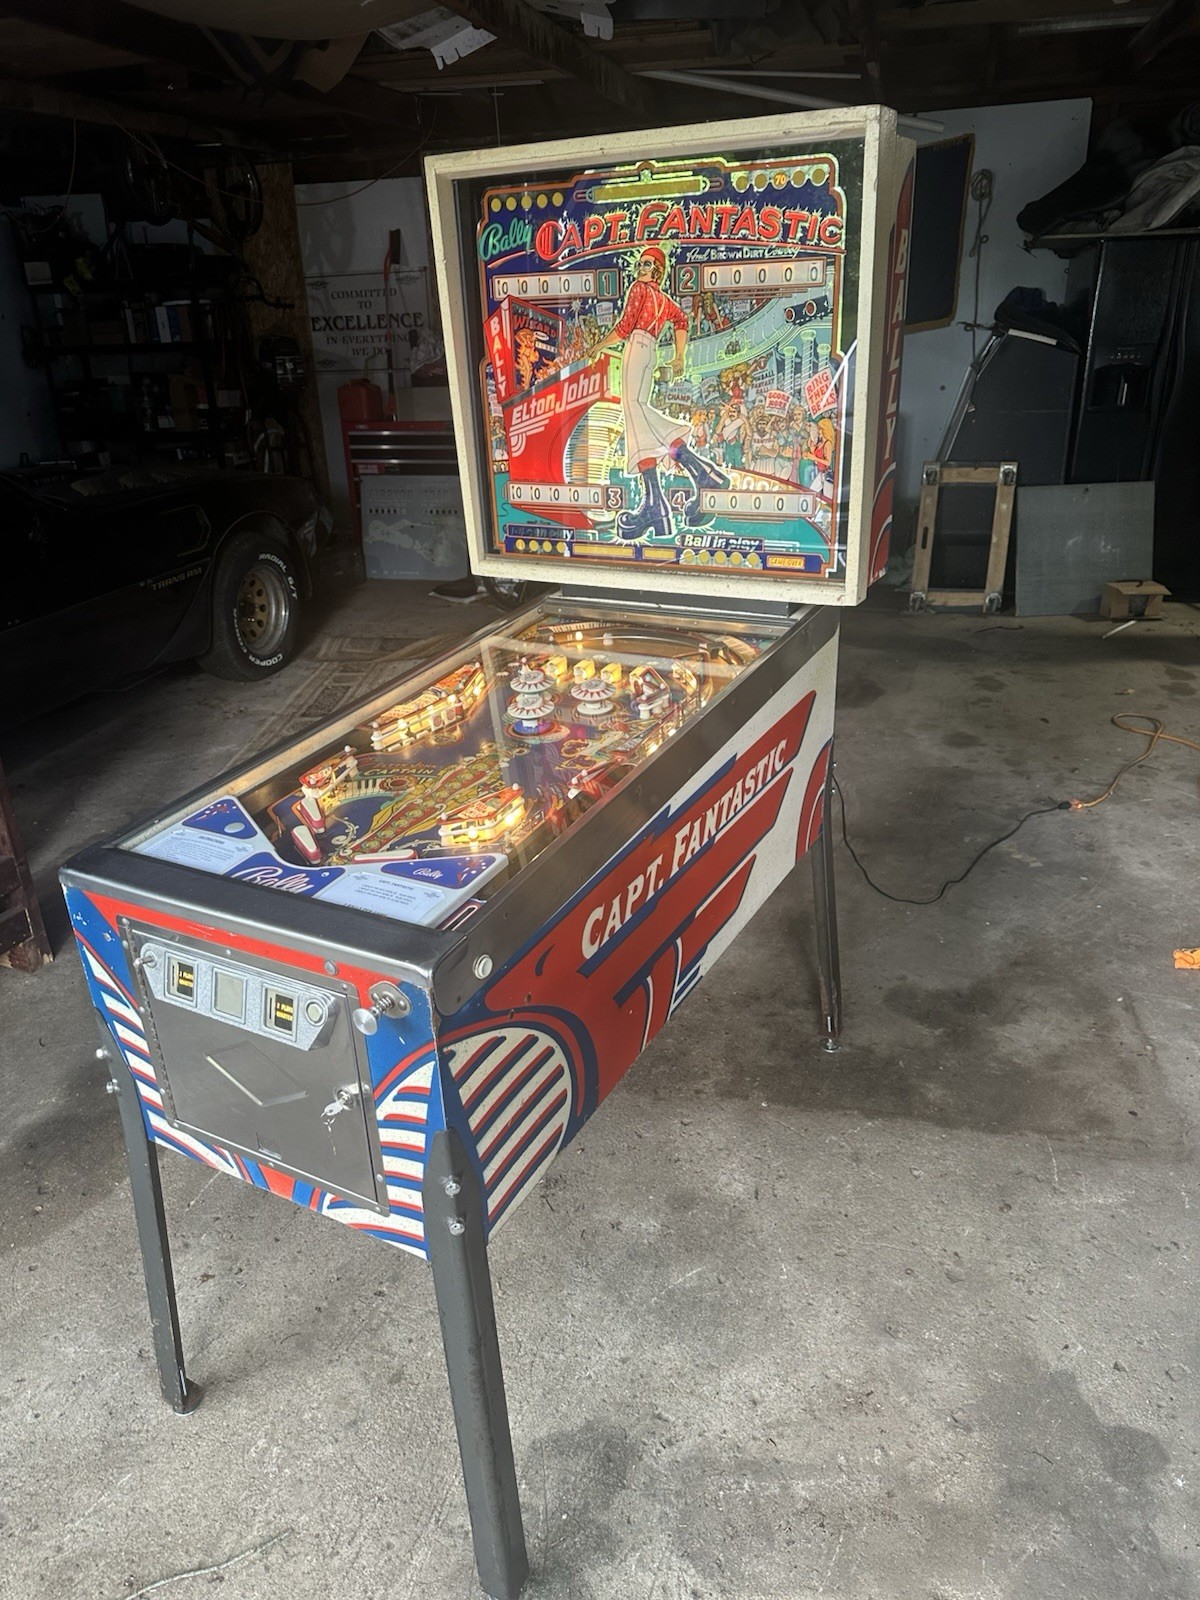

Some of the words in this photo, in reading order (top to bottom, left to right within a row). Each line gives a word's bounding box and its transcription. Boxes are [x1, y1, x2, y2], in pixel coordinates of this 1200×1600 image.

[774, 174, 787, 185] 70
[478, 217, 532, 262] Bally
[535, 212, 628, 261] CAPT.
[636, 201, 844, 245] FANTASTIC
[711, 248, 742, 260] BROWN
[743, 246, 764, 259] DIRT
[602, 272, 612, 296] 1
[680, 266, 695, 291] 2
[358, 301, 372, 310] TO
[311, 312, 424, 331] EXCELLENCE
[327, 336, 338, 345] IN
[342, 333, 410, 344] EVERYTING
[885, 229, 909, 459] BALLY
[352, 347, 369, 356] WE
[490, 316, 506, 397] BALLY
[806, 371, 829, 395] RING
[555, 373, 600, 413] John
[667, 393, 691, 402] CHAMP
[767, 391, 790, 402] SCORE
[608, 488, 622, 508] 3
[671, 491, 686, 511] 4
[684, 534, 711, 548] Ball
[713, 535, 727, 550] in
[728, 538, 760, 552] play
[151, 573, 187, 591] TRANS
[258, 553, 288, 573] RADIAL
[287, 576, 300, 600] G/T
[249, 653, 284, 667] COOPER
[364, 768, 434, 777] CAPTAIN
[581, 853, 664, 960] CAPT.
[669, 738, 788, 879] FANTASTIC
[413, 867, 444, 880] Bally
